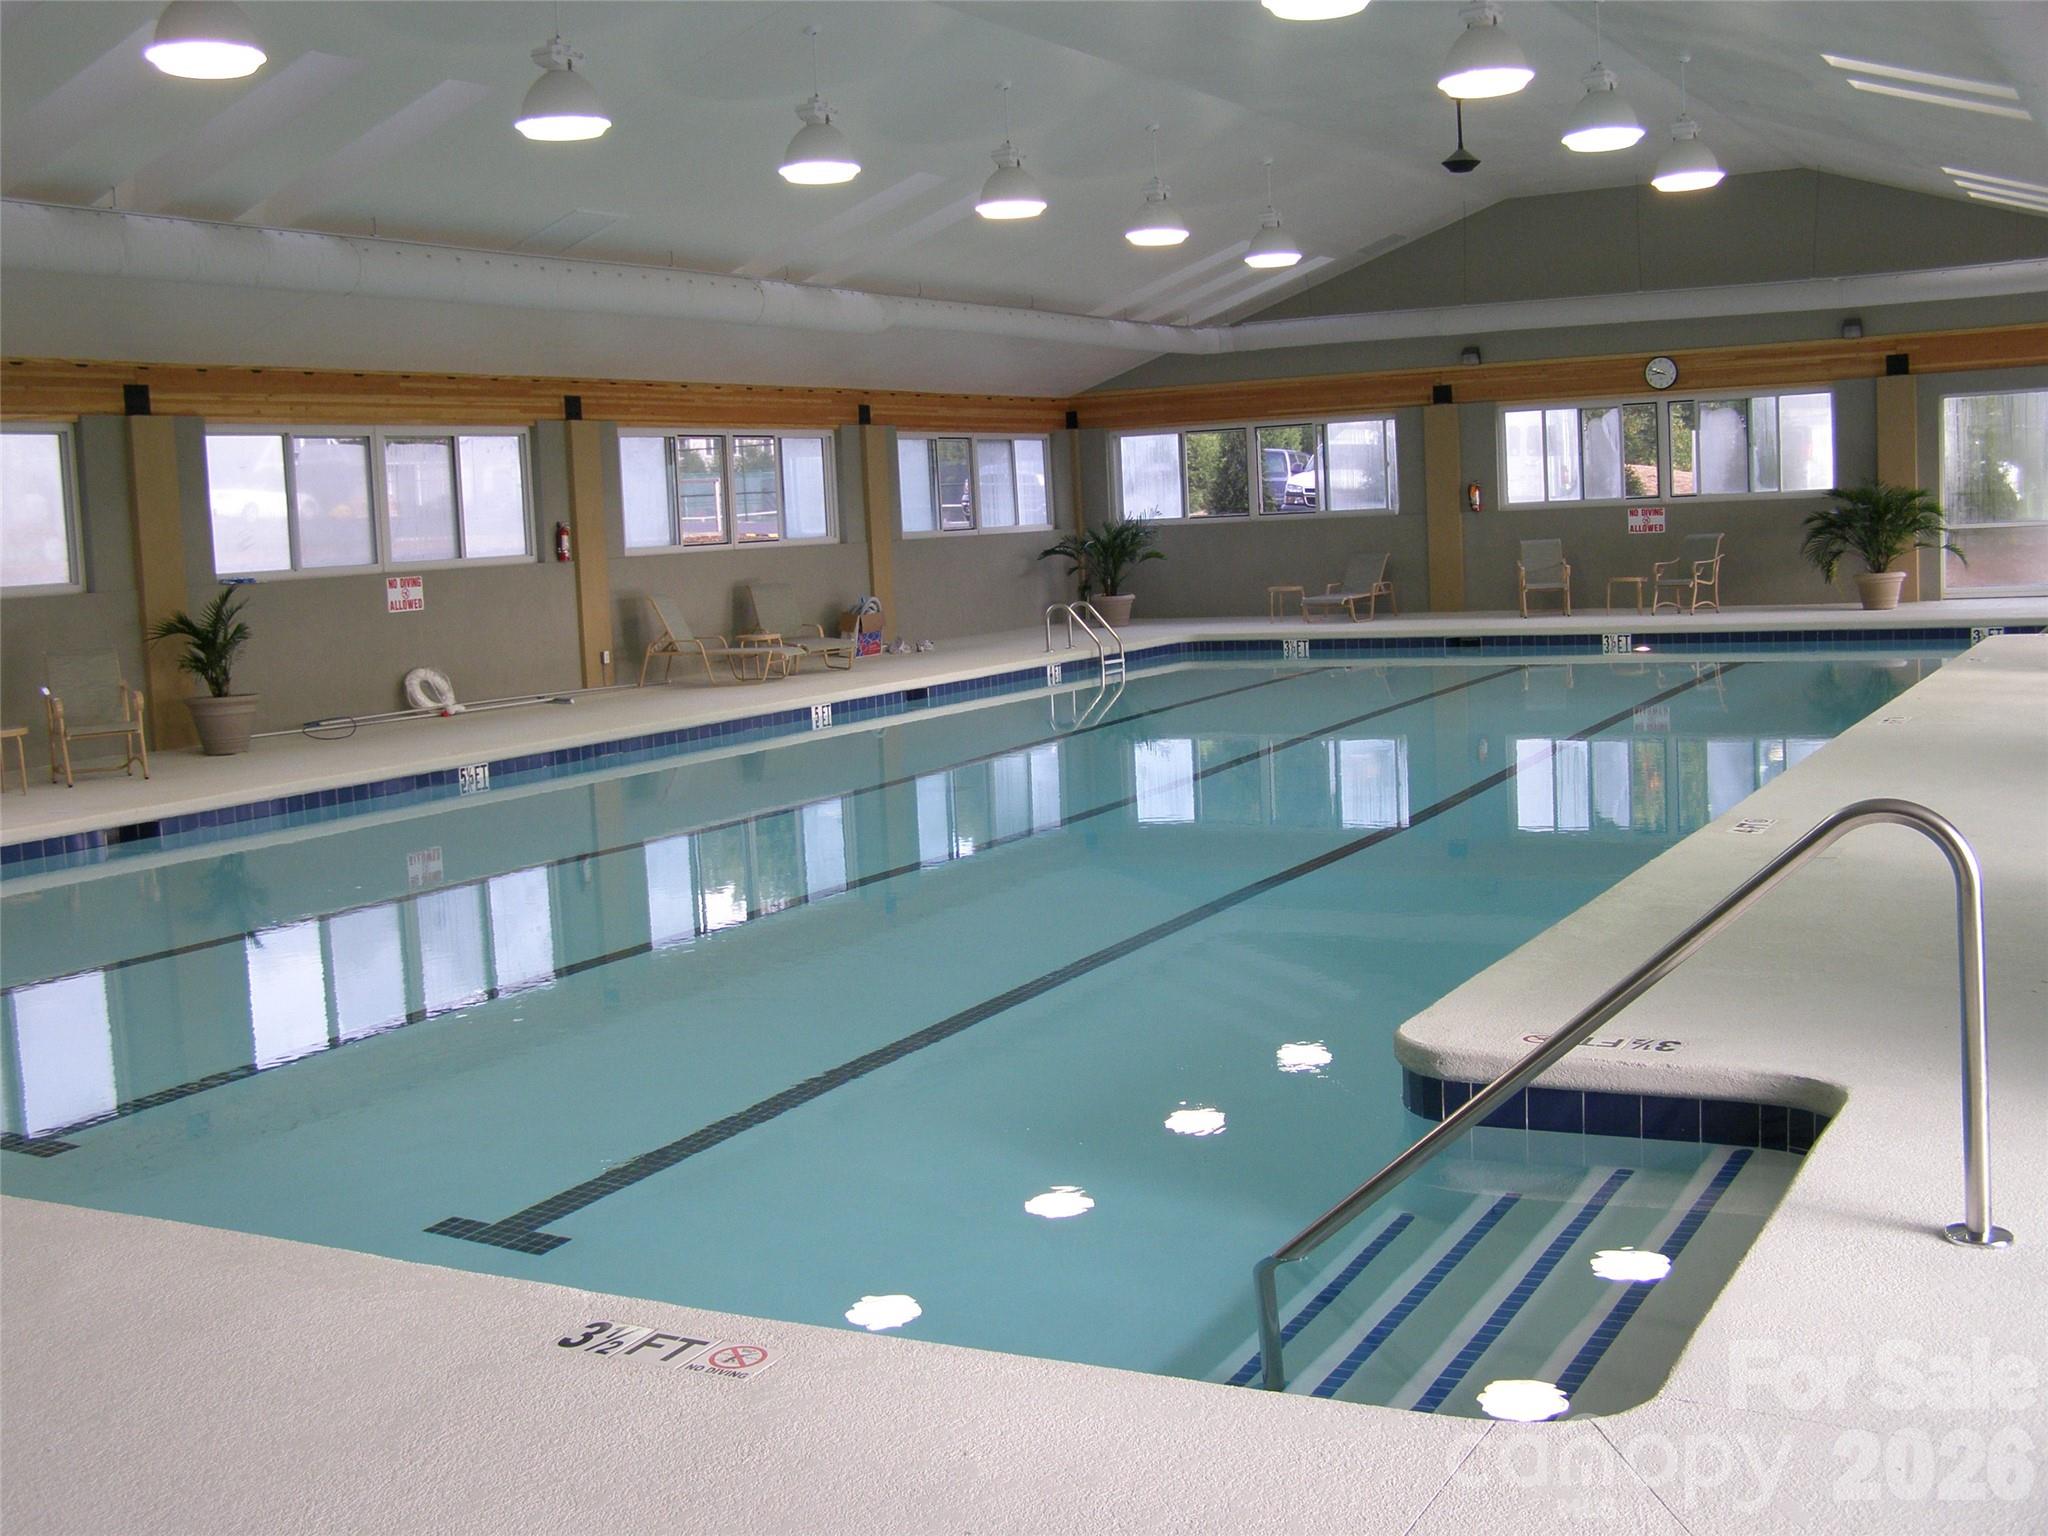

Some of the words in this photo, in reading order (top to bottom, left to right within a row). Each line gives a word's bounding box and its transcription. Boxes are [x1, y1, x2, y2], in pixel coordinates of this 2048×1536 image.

[1629, 524, 1664, 532] ALLOWED
[390, 599, 422, 611] ALLOWED
[625, 1333, 709, 1361] FT
[686, 1363, 704, 1373] NO
[706, 1366, 749, 1380] DIVING
